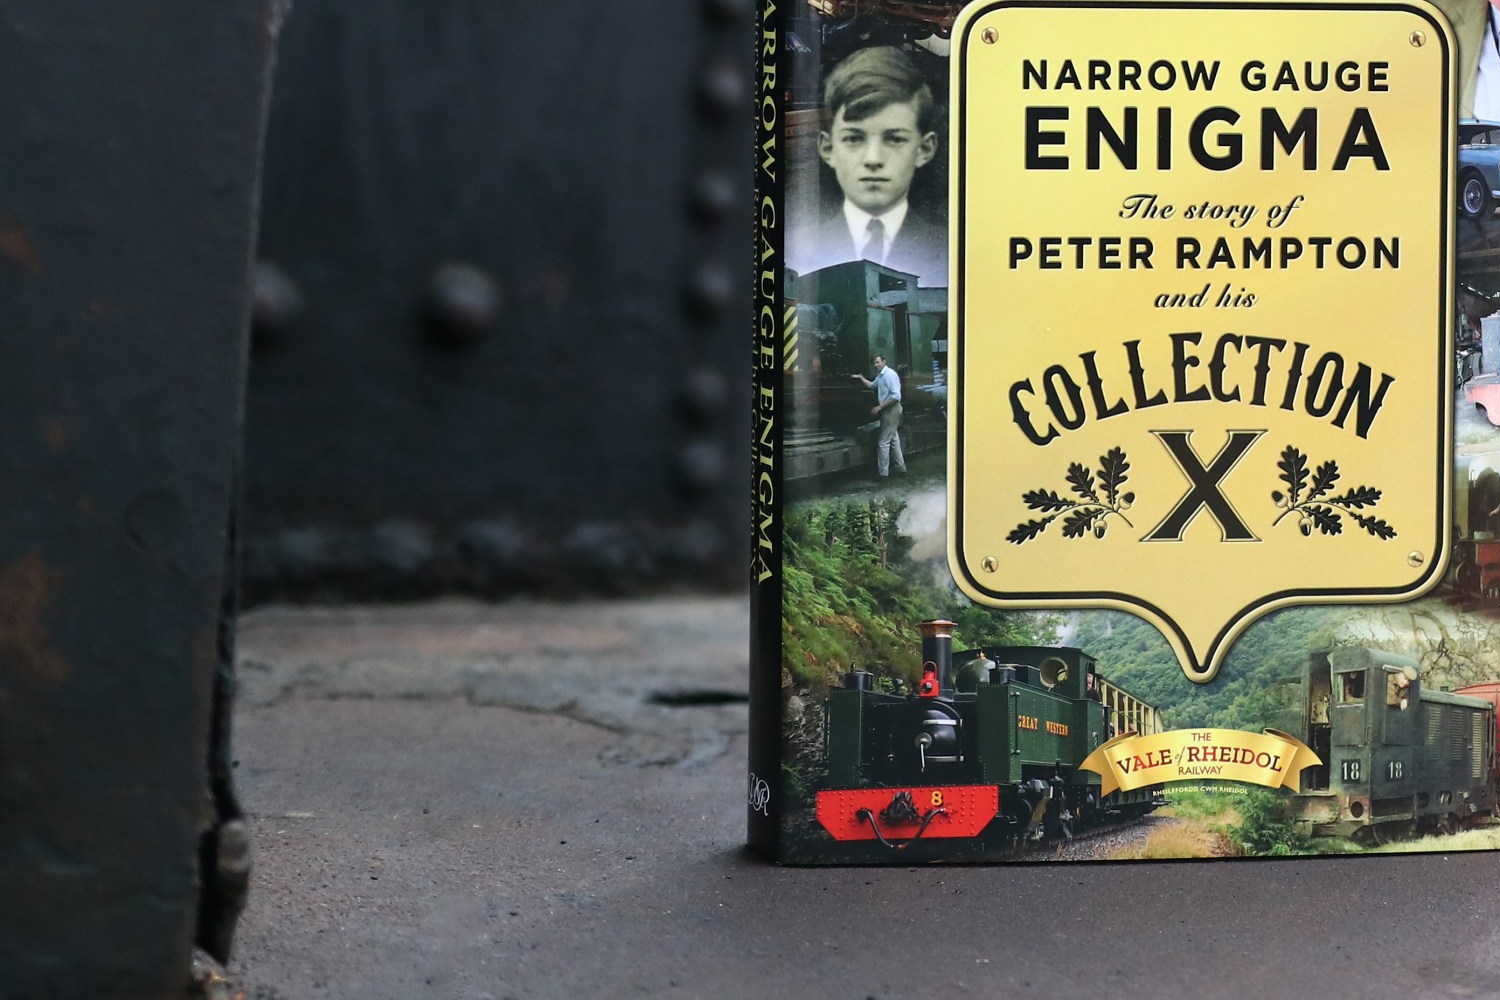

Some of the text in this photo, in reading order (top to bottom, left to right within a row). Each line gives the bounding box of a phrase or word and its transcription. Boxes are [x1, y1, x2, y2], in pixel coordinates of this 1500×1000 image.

[1022, 59, 1389, 92] NARROW GAUGE
[1025, 106, 1391, 171] ENIGMA
[1119, 194, 1304, 228] The story of
[1009, 236, 1400, 270] PETER RAMPTON
[759, 195, 776, 370] GAUGE
[1154, 283, 1257, 308] and his
[1008, 331, 1396, 446] COLLECTION
[758, 385, 775, 584] ENIGMA
[1138, 428, 1268, 543] X
[1018, 715, 1038, 730] GREAT
[1191, 732, 1212, 742] THE
[1116, 746, 1283, 774] VALE of RHEIDOL
[1178, 766, 1224, 776] RAILWAY
[1341, 761, 1360, 781] 18
[1388, 761, 1403, 779] 18
[930, 790, 944, 807] 8
[1200, 785, 1218, 793] CWM
[1219, 786, 1249, 795] RHEIDOL
